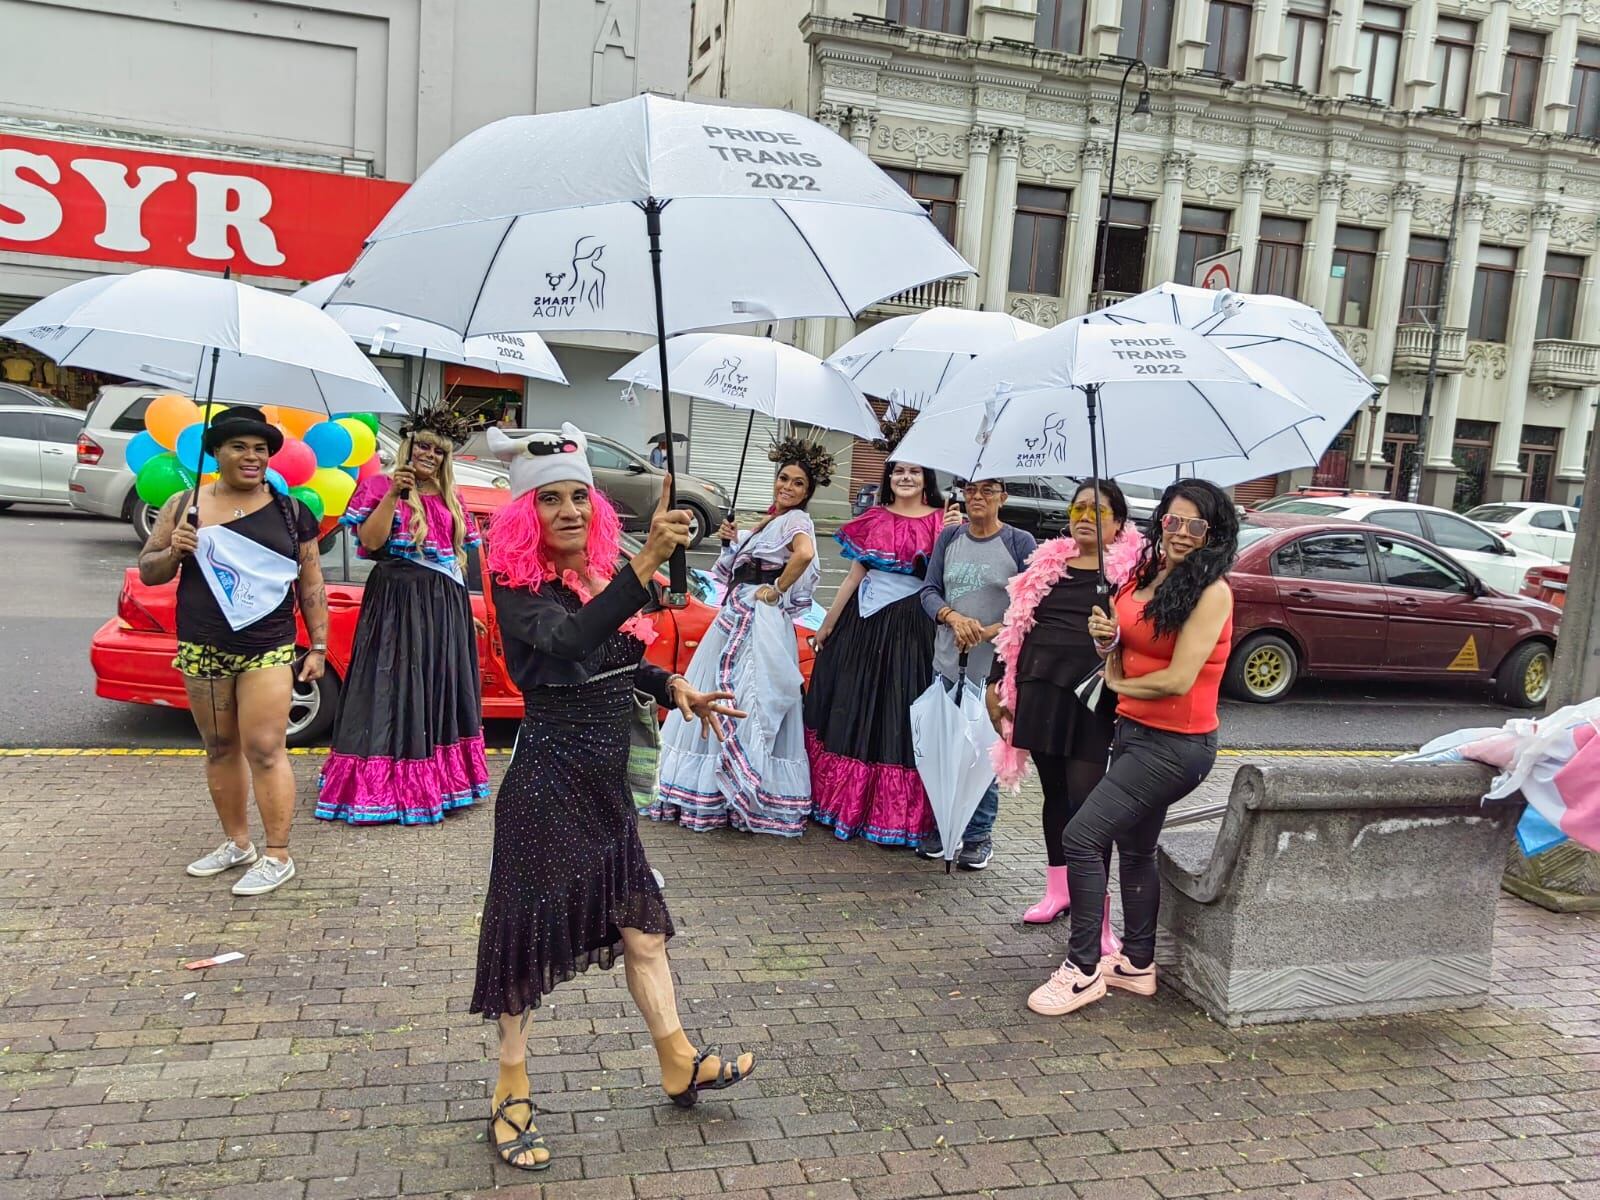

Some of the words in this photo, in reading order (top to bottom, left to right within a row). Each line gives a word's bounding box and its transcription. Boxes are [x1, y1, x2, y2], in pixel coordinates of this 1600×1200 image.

[702, 125, 802, 145] PRIDE
[708, 145, 823, 167] TRANS
[745, 172, 822, 192] 2022
[1110, 338, 1176, 347] PRIDE
[496, 346, 525, 361] 2022
[1112, 350, 1187, 360] TRANS
[1133, 363, 1183, 375] 2022
